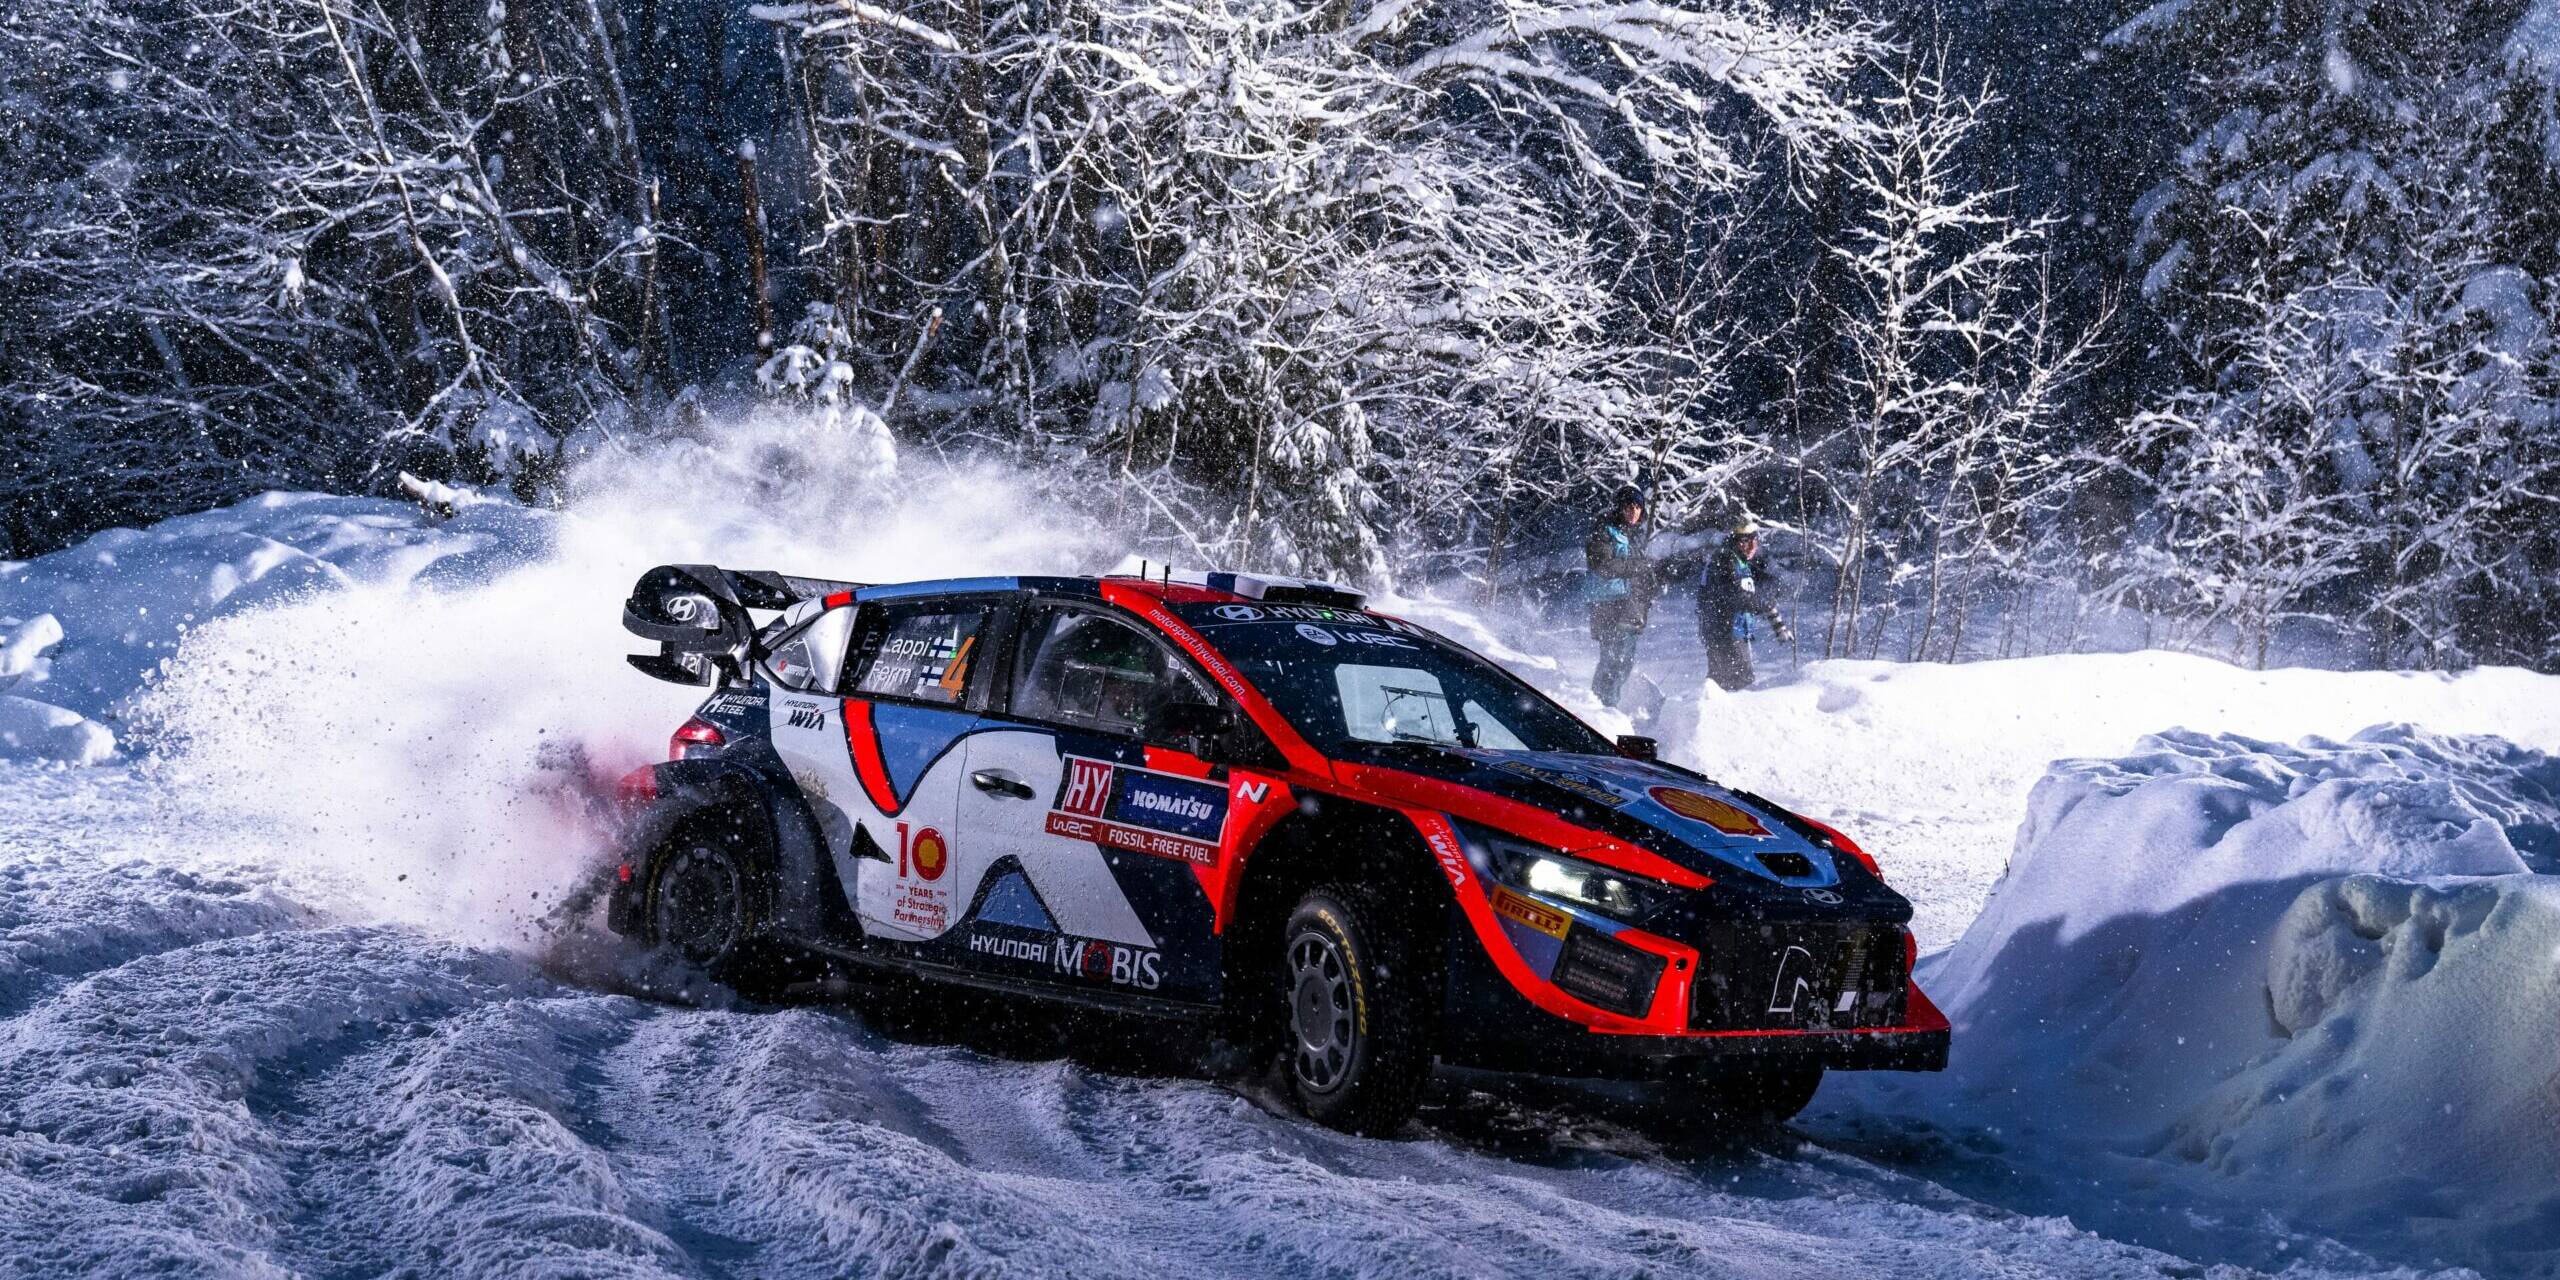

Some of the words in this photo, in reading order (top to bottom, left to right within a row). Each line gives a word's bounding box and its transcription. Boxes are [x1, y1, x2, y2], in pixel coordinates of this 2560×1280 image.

[881, 632, 932, 661] Lappi
[1332, 629, 1420, 651] WRC
[1148, 608, 1246, 697] motorsport.hyundai.com
[867, 660, 912, 684] Ferm
[939, 635, 976, 700] 4
[716, 704, 746, 716] STEEL
[724, 694, 768, 706] HYUNDAI
[784, 699, 819, 710] HYUNDAI
[787, 708, 825, 731] WIA
[1066, 764, 1110, 812] HY
[1132, 789, 1214, 821] KOMATSU
[1052, 818, 1095, 837] WRC
[896, 821, 948, 882] 10
[1108, 828, 1180, 855] FOSSIL-FREE
[1182, 844, 1211, 863] FUEL
[909, 885, 934, 899] YEARS
[897, 895, 906, 907] of
[907, 897, 947, 916] Strategic
[1496, 891, 1565, 932] PIRELLI
[894, 908, 946, 930] Partnership
[969, 933, 1048, 963] HYUNDAI
[1054, 937, 1161, 991] MOBIS
